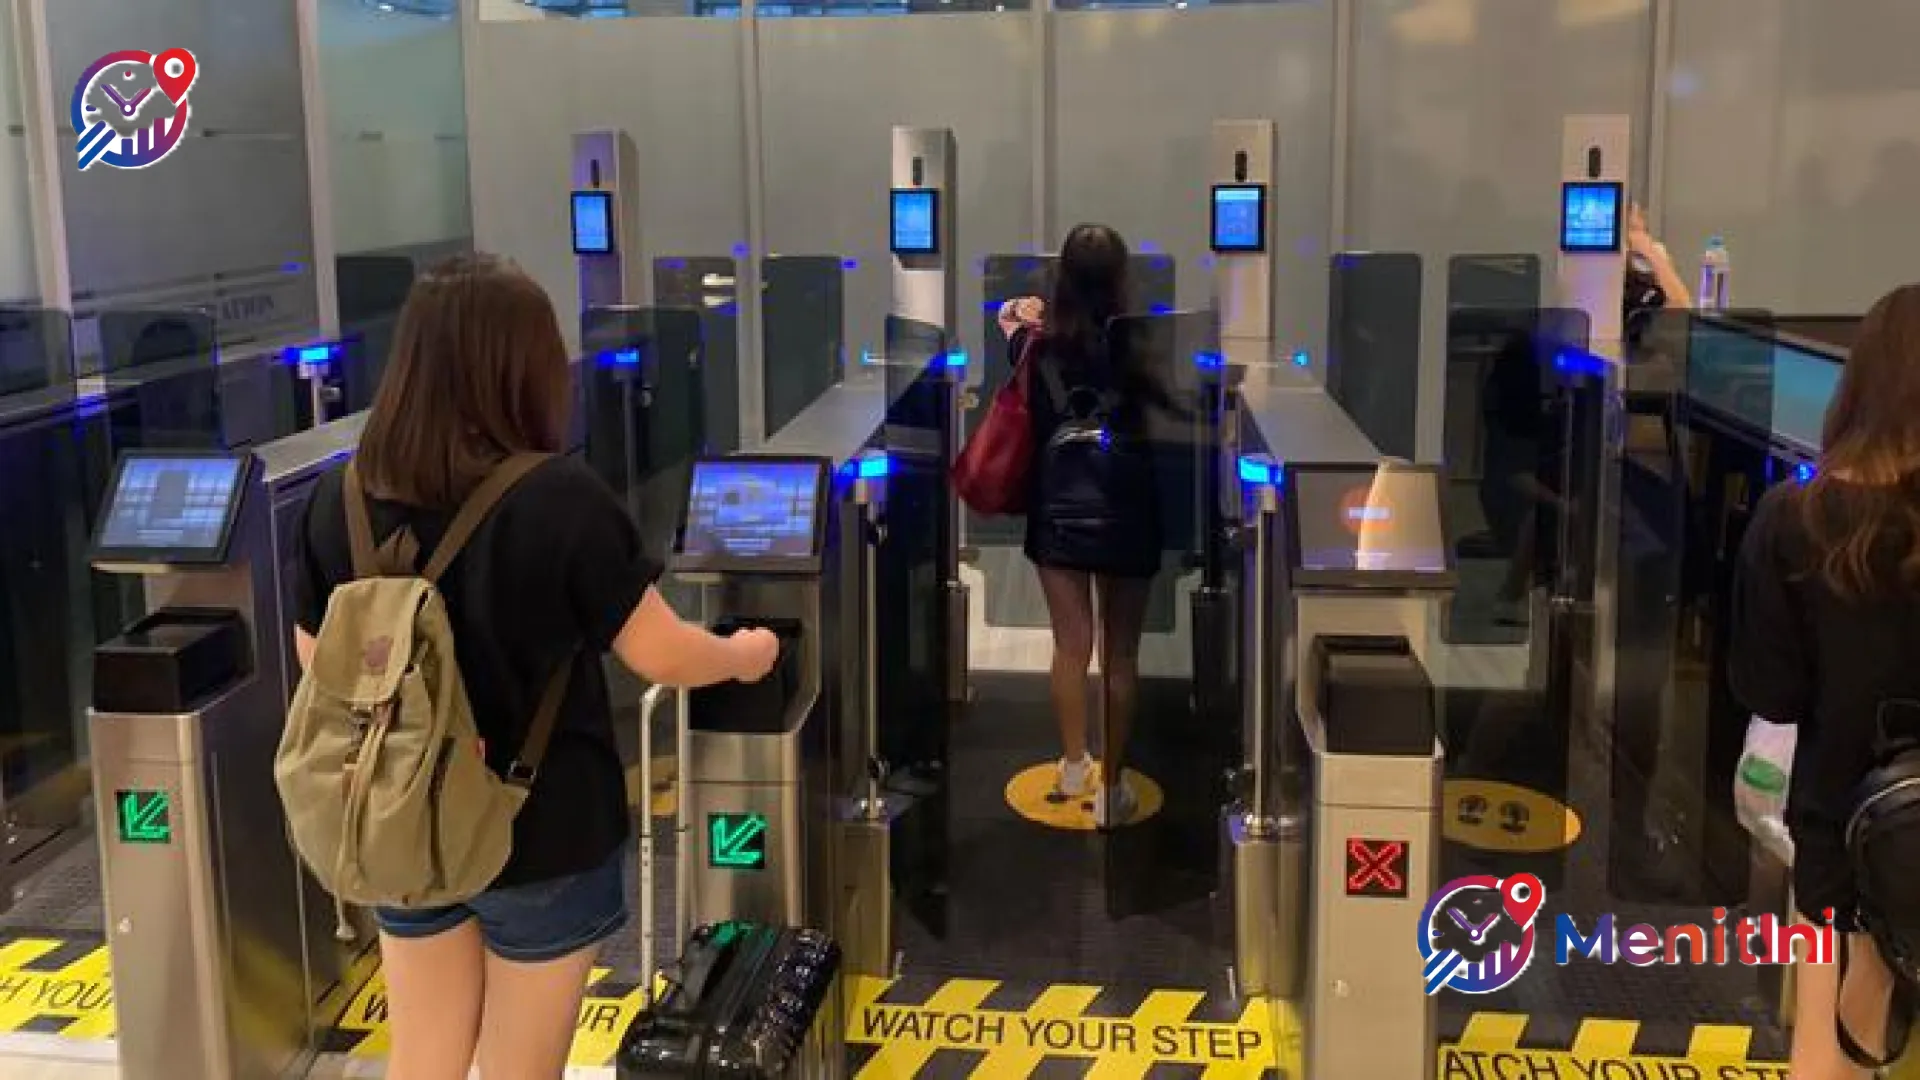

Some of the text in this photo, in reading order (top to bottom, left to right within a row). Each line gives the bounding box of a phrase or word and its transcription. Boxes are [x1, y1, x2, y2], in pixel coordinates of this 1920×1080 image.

[863, 1007, 1262, 1061] WATCH YOUR STEP
[1446, 1050, 1561, 1080] ATCH
